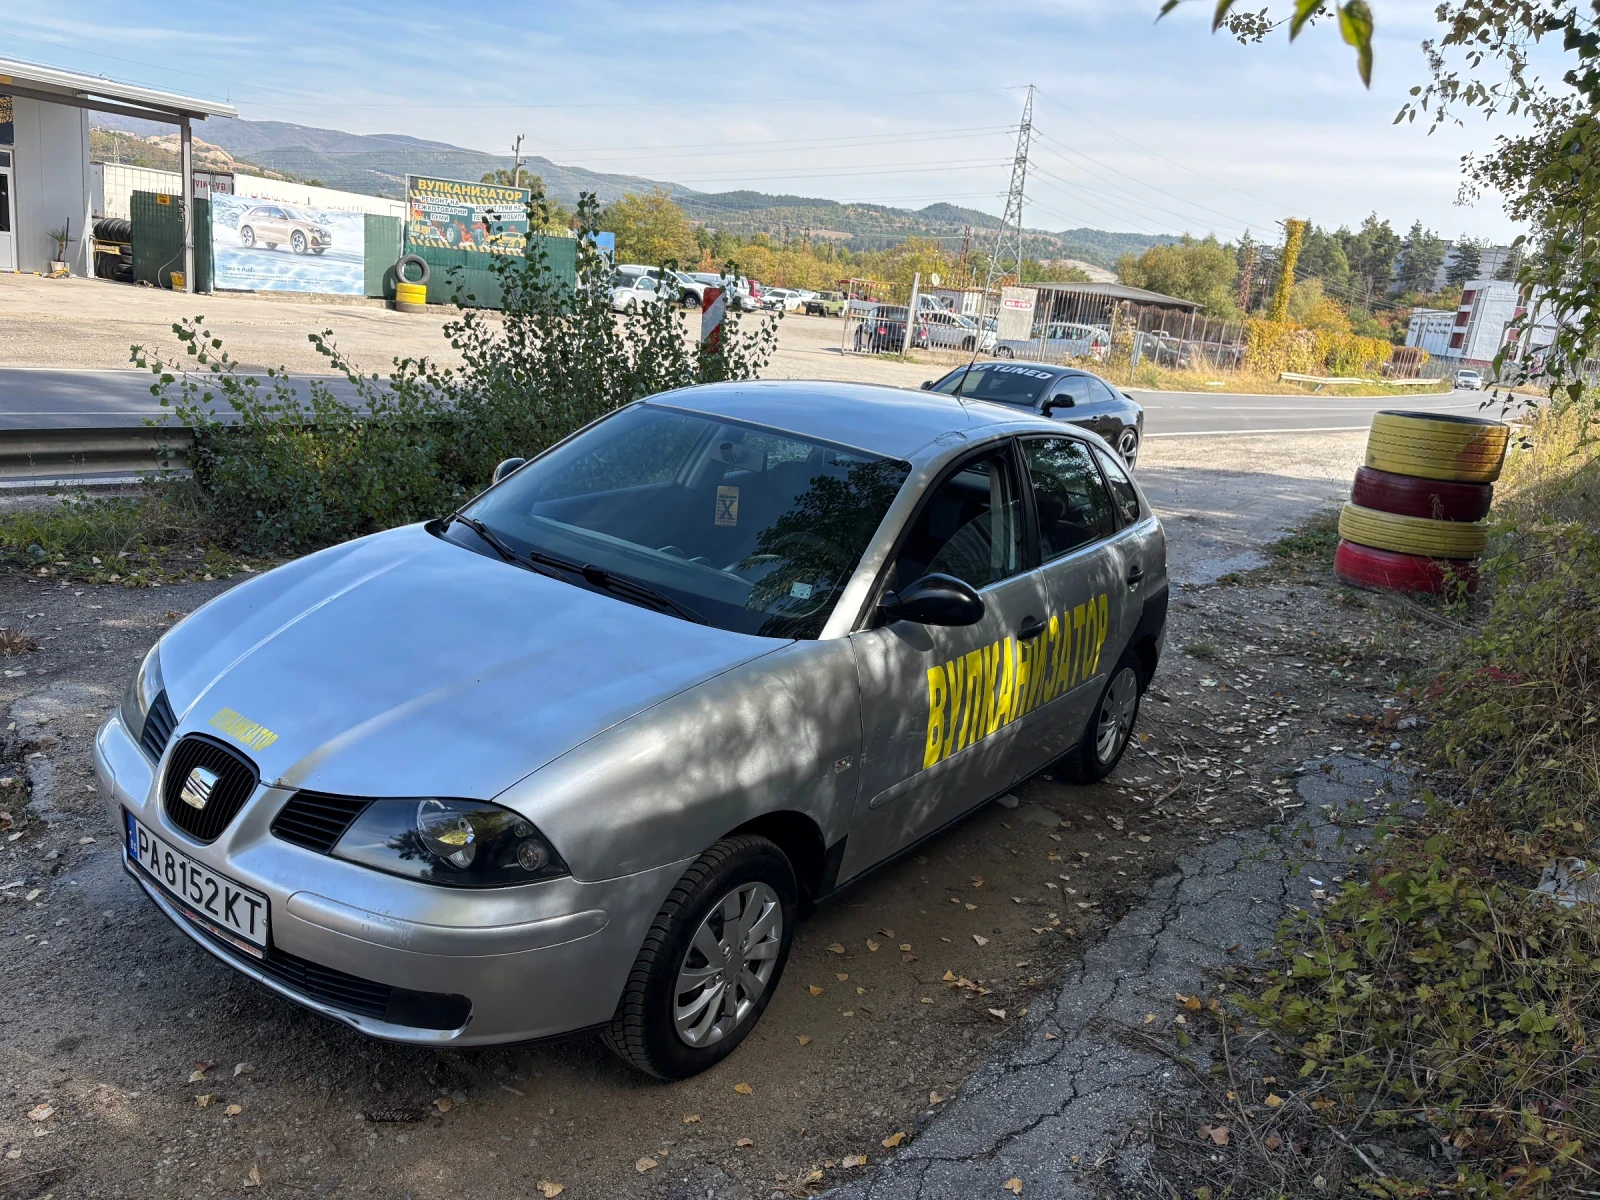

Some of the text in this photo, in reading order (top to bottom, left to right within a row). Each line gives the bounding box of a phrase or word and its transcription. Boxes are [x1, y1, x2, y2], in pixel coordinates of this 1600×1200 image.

[418, 179, 522, 201] ВУЛКАНИЗАТОР
[413, 203, 468, 215] ТЕЖКОТОВАРНИ
[421, 195, 448, 205] РЕМОНТ
[993, 365, 1053, 380] TUNED
[922, 593, 1109, 770] ВУЛКАНИЗАТОР
[137, 826, 262, 936] PA8152KT
